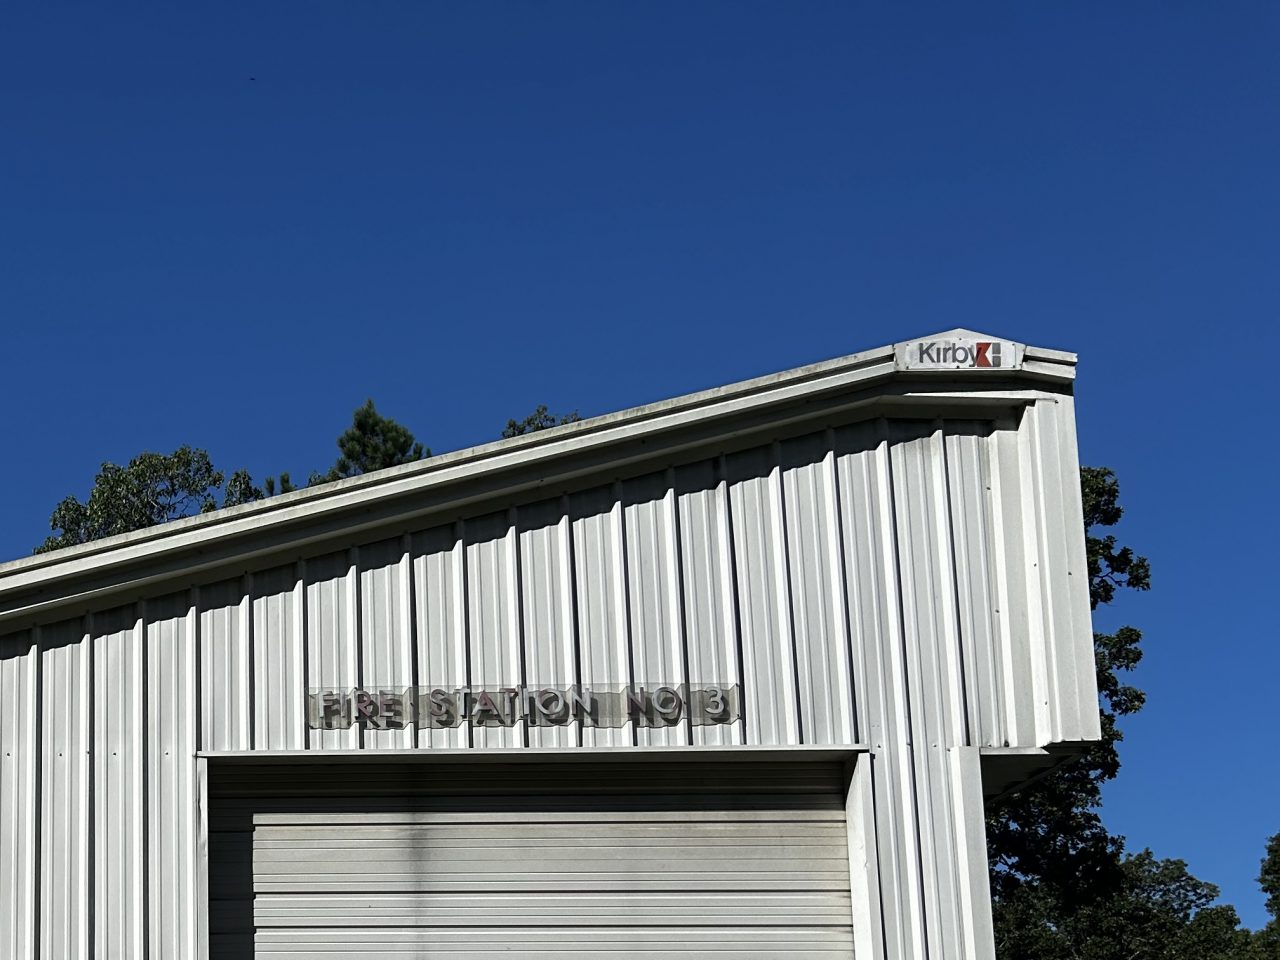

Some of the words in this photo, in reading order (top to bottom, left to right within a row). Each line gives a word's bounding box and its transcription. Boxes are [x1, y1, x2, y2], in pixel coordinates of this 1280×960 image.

[919, 342, 981, 367] Kirby
[318, 688, 395, 718] FIRE
[430, 687, 592, 718] STATION
[704, 685, 725, 715] 3
